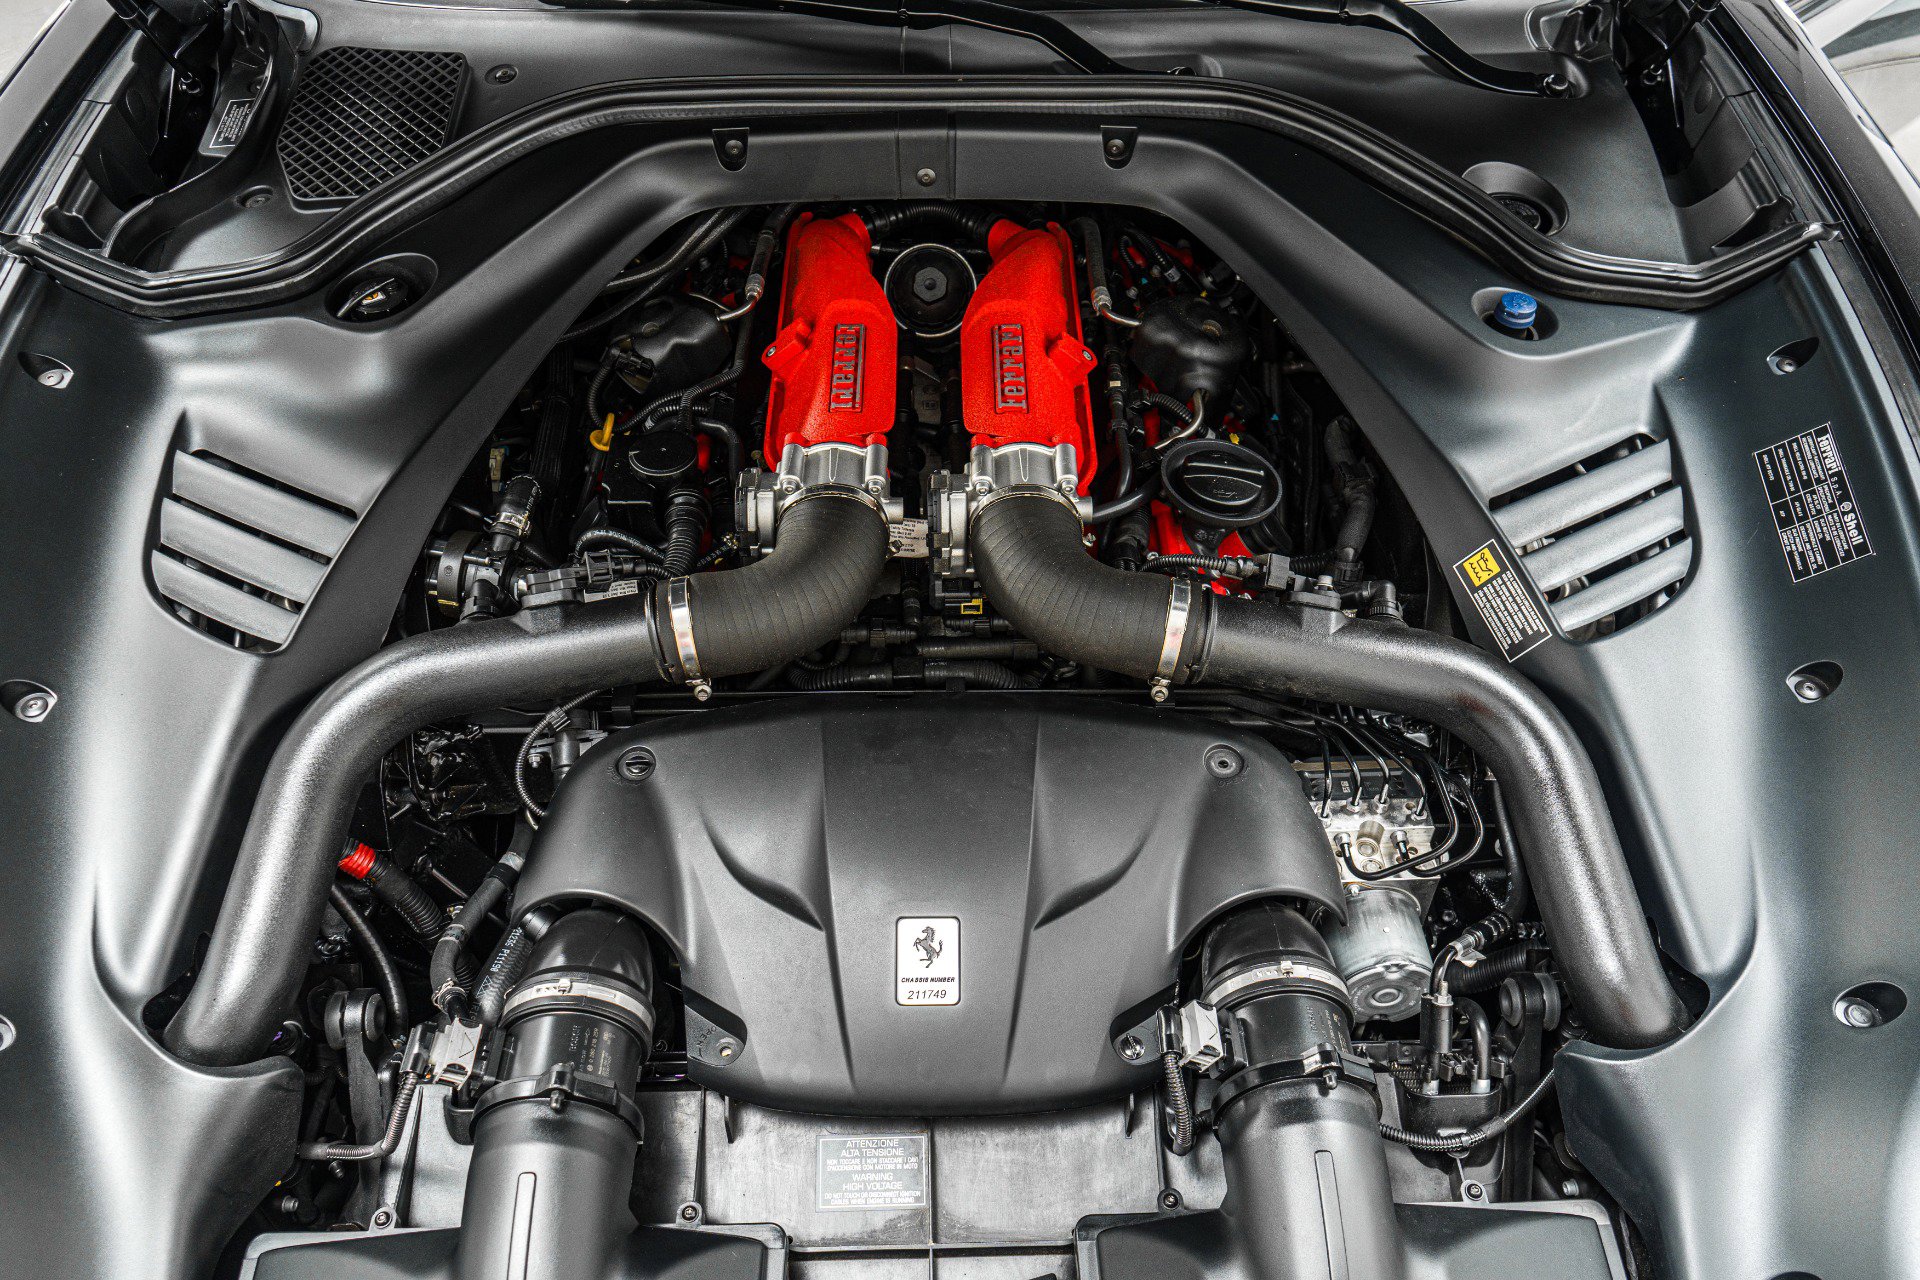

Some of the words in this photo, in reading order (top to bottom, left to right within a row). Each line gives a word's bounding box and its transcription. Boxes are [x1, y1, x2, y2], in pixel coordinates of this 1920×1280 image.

[831, 323, 865, 411] Ferrari
[992, 323, 1027, 411] Ferrari
[1817, 434, 1841, 474] Ferrari
[1844, 512, 1863, 545] Shell
[907, 989, 947, 1000] 211749
[846, 1139, 900, 1148] ATTENZIONE
[841, 1149, 860, 1158] ALTA
[862, 1148, 905, 1156] TENSIONE
[852, 1172, 894, 1181] WARNING
[842, 1182, 864, 1190] HIGH
[866, 1181, 902, 1190] VOLTAGE
